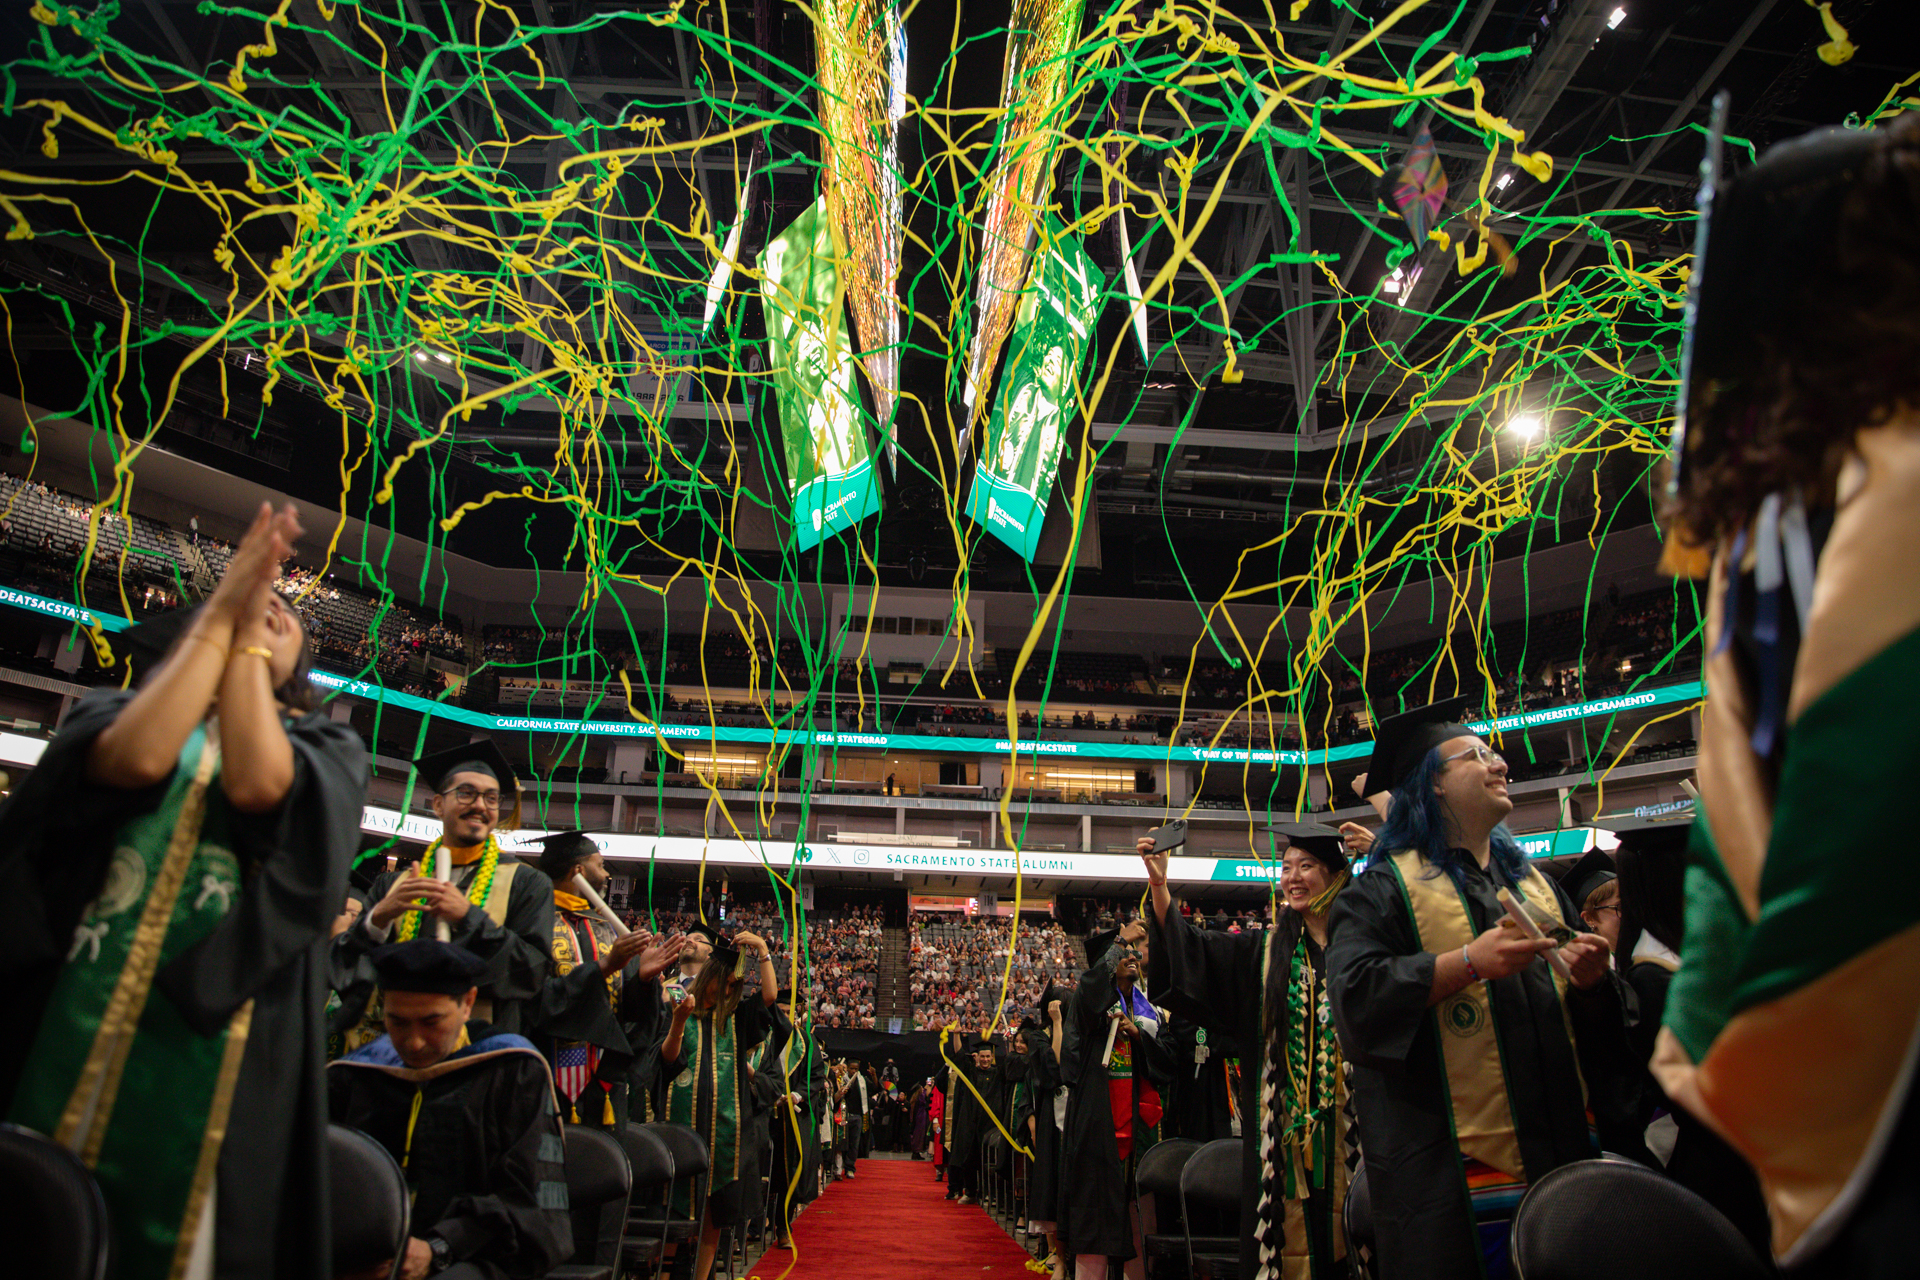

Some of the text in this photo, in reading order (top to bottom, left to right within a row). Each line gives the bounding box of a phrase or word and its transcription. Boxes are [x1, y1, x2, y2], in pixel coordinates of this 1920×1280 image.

[823, 491, 857, 514] ACRAMENTO
[823, 510, 838, 524] TATE
[993, 513, 1007, 528] STATE
[995, 505, 1025, 532] SACRAMENTO
[1492, 717, 1519, 730] STATE
[1520, 706, 1582, 725] UNIVERSITY,
[1583, 693, 1656, 714] SACRAMENTO
[496, 718, 700, 737] CALIFORNIA STATE UNIVERSITY, SACAMENTO
[1202, 750, 1220, 758] WAY
[1221, 751, 1234, 759] OF
[886, 853, 976, 867] SACRAMENTO
[980, 857, 1018, 869] STATE
[1023, 859, 1073, 870] ALUMNI
[1235, 839, 1551, 878] STINGE UP!
[615, 879, 625, 891] 112
